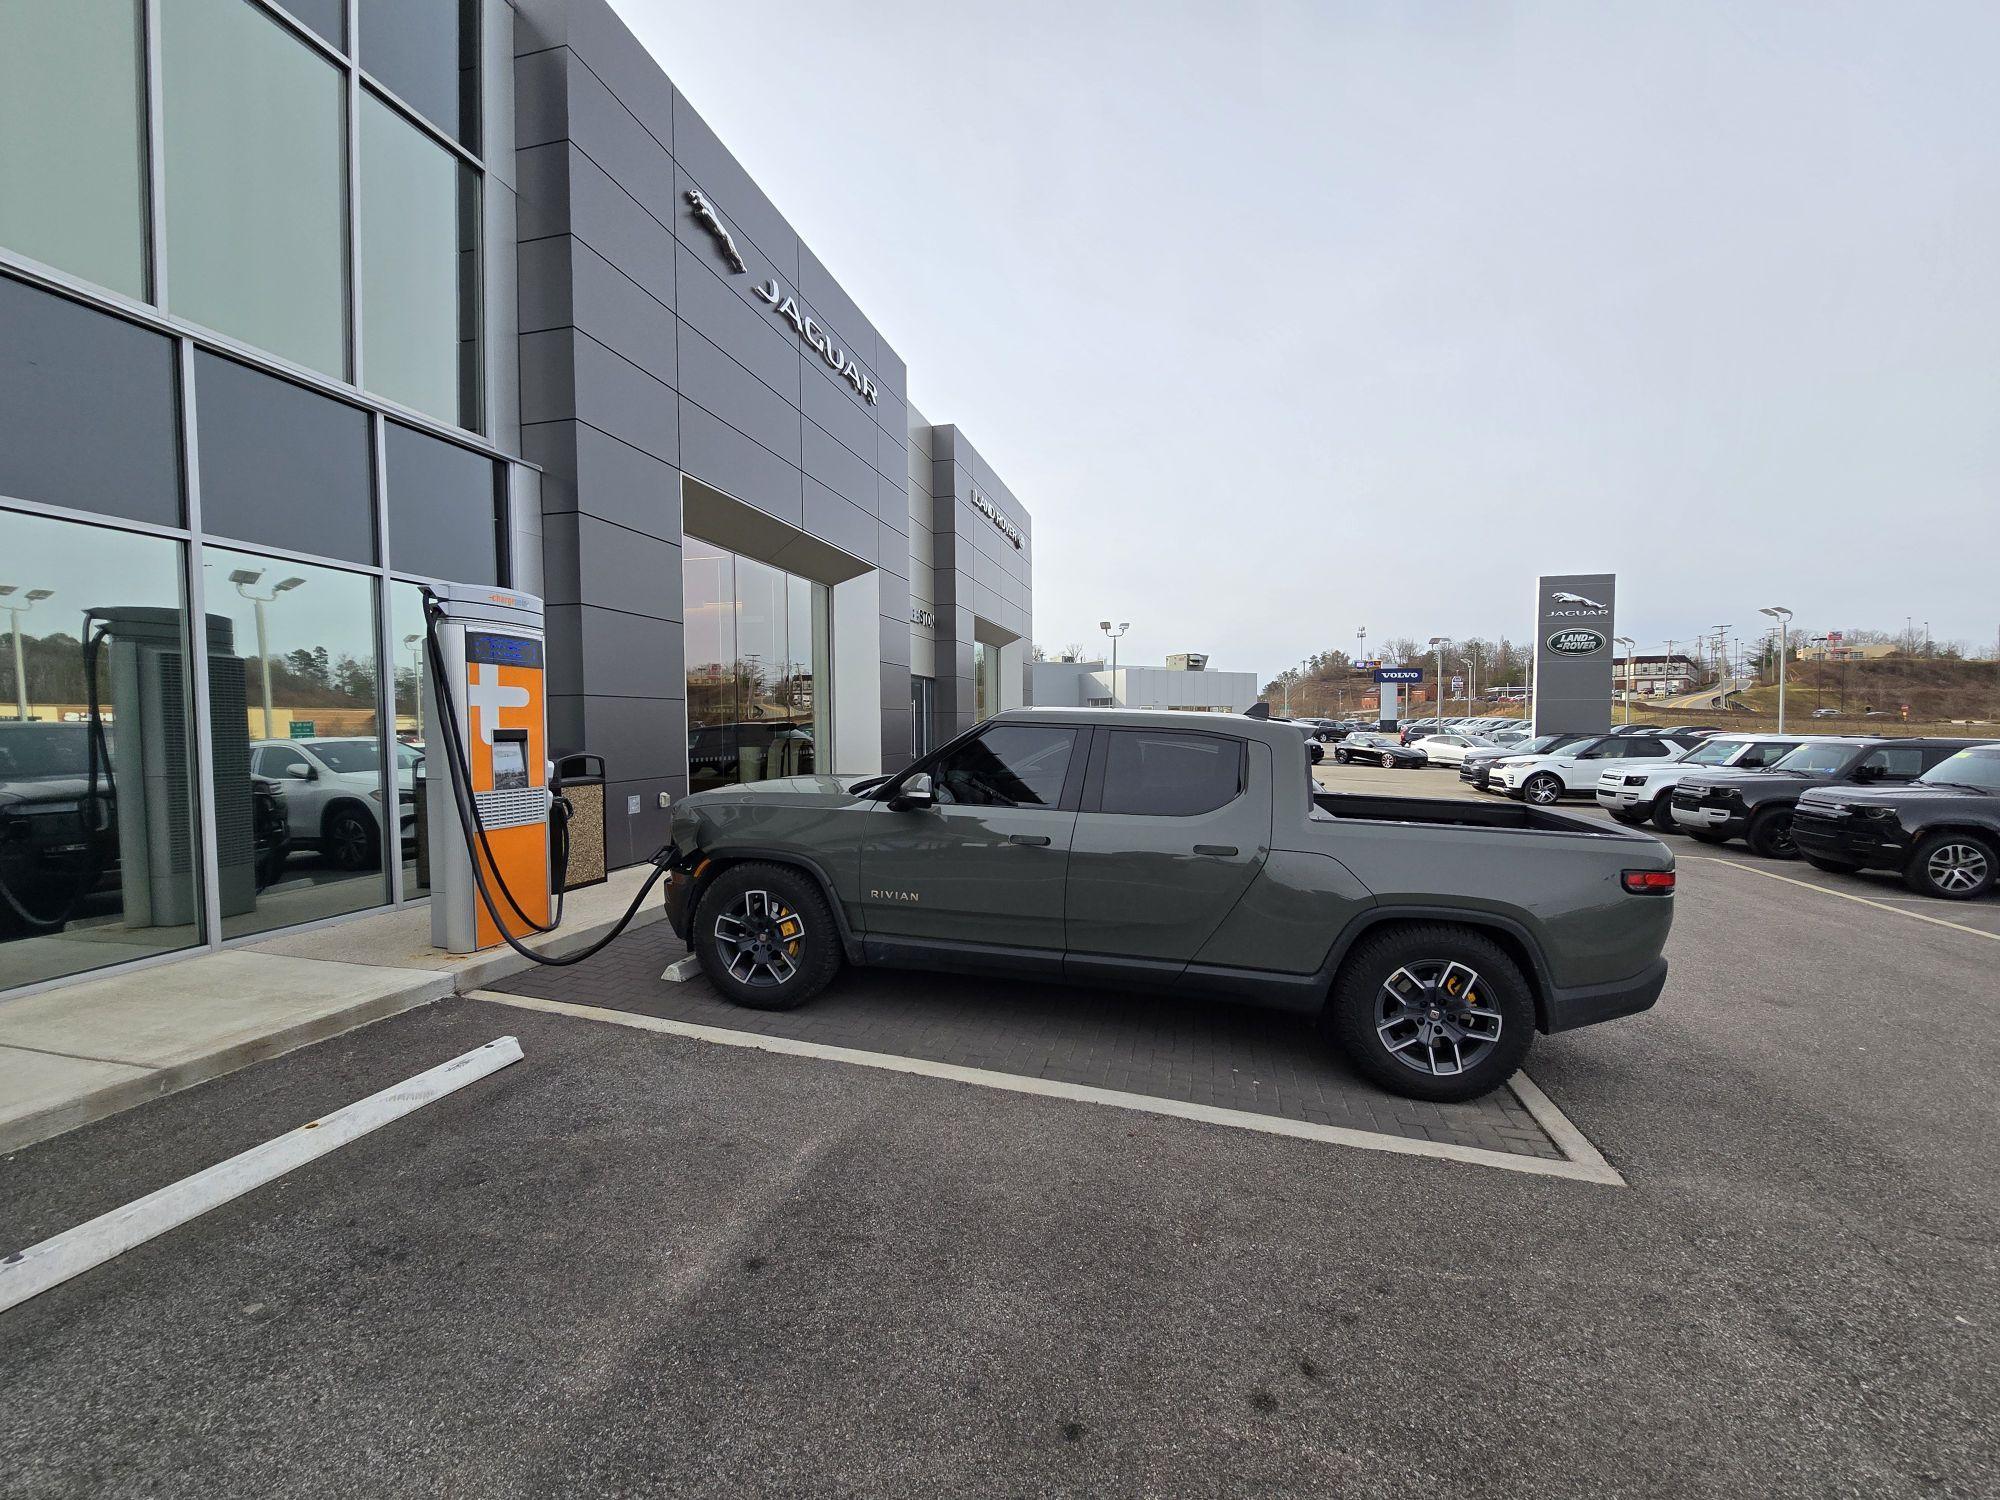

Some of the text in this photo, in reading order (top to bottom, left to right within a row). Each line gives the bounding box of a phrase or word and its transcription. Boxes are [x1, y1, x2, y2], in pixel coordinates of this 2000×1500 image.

[754, 278, 878, 406] JAGUAR
[971, 489, 1017, 543] LAND ROVER
[1546, 609, 1609, 617] JAGUAR
[1560, 633, 1588, 642] LAND
[1562, 641, 1597, 650] ROVER
[870, 889, 919, 901] RIVIAN
